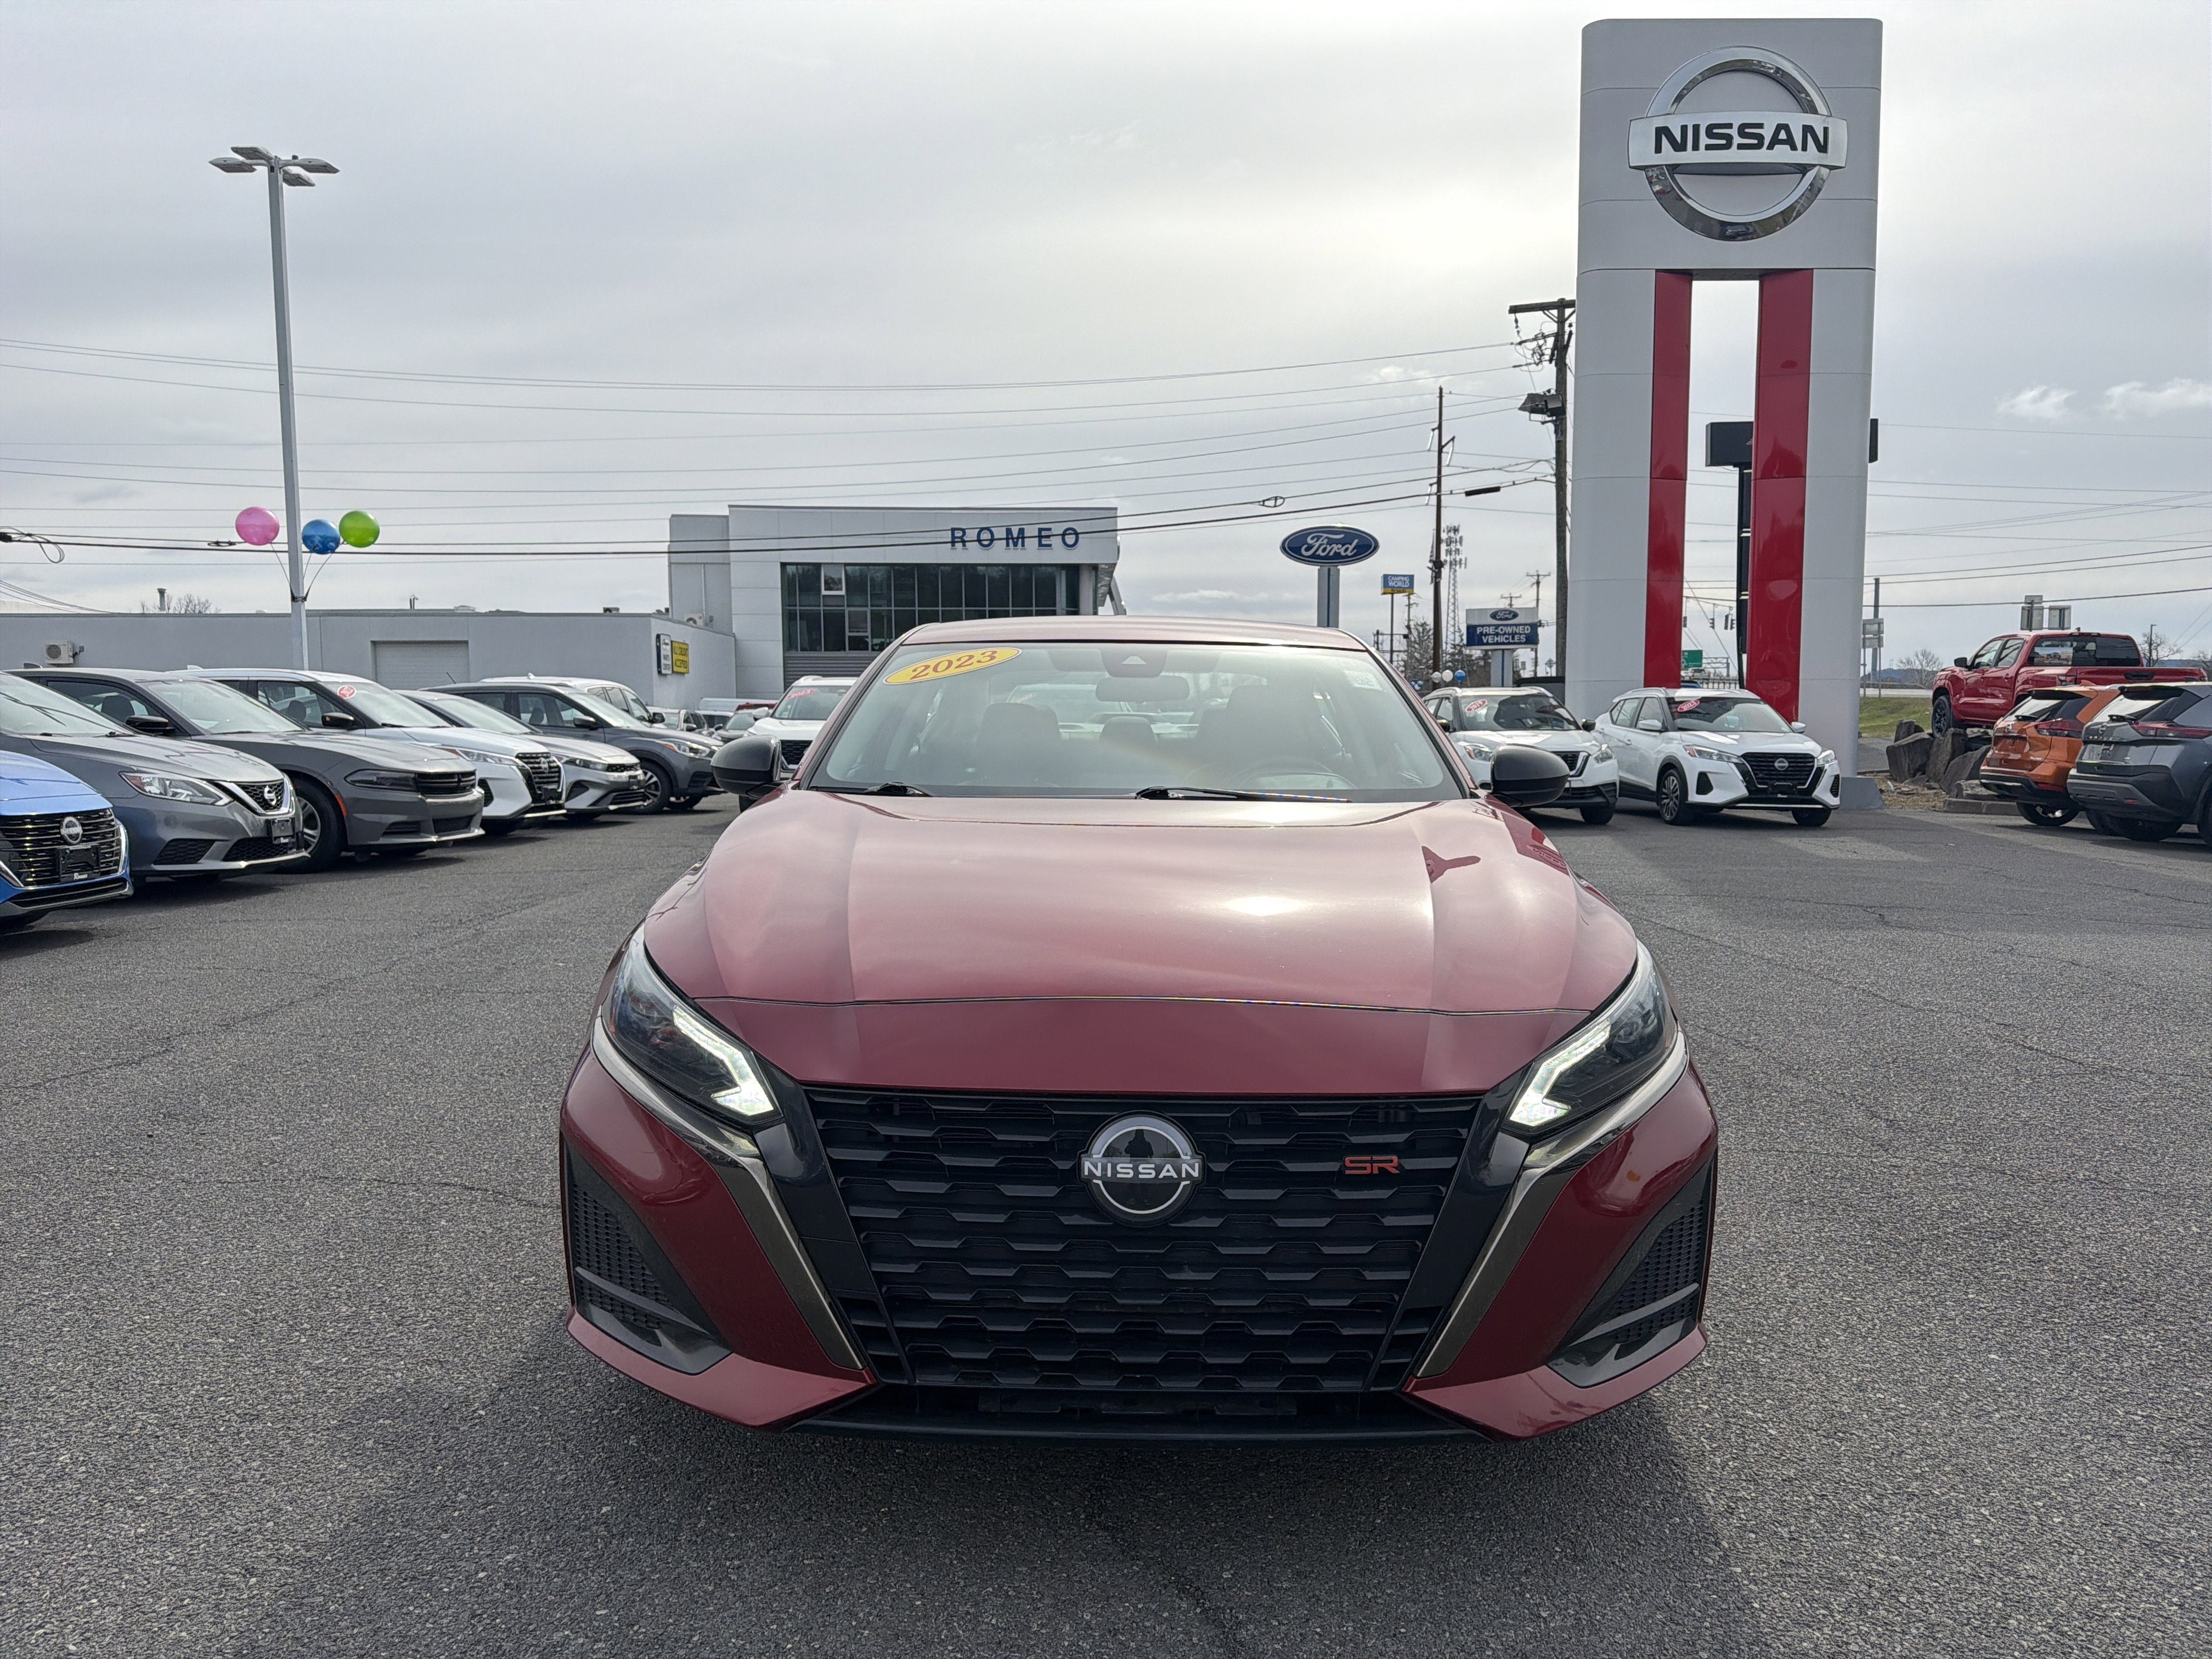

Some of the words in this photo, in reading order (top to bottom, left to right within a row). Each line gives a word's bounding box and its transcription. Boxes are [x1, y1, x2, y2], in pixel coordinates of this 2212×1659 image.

[1654, 122, 1829, 154] NISSAN
[950, 527, 1080, 548] ROMEO
[1301, 533, 1359, 556] Ford
[1496, 611, 1514, 619] Ford
[1476, 625, 1531, 635] PRE-OWNED
[1482, 634, 1526, 643] VEHICLES
[910, 650, 998, 680] 2023
[1084, 1161, 1199, 1178] NISSAN
[1344, 1155, 1400, 1174] SR
